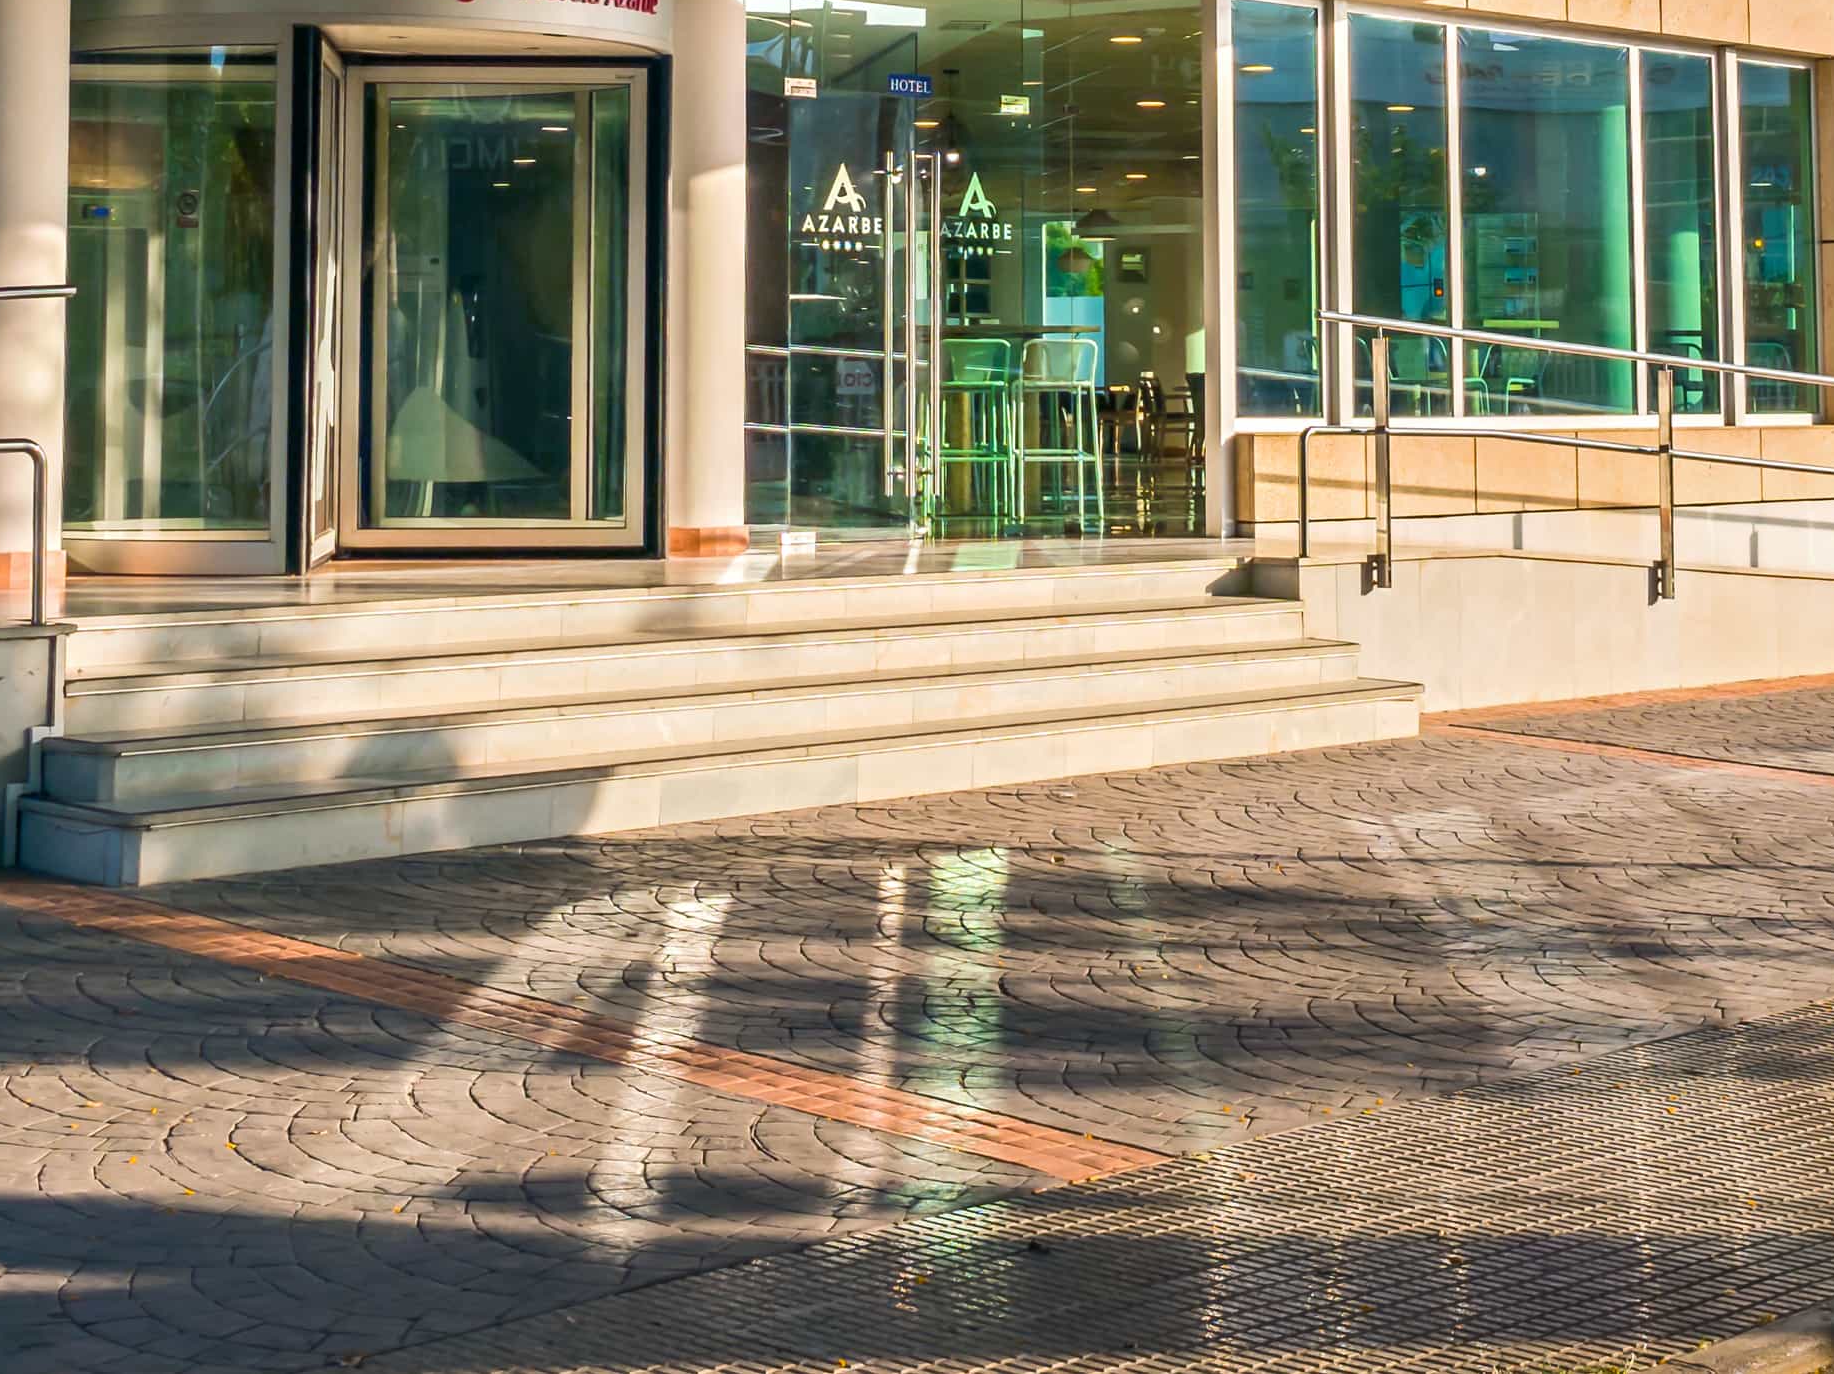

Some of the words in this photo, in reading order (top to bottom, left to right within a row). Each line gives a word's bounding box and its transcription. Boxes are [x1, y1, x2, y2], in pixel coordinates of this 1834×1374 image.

[890, 78, 931, 94] HOTEL
[801, 214, 883, 235] AZARBE
[940, 221, 1013, 241] AZARBE
